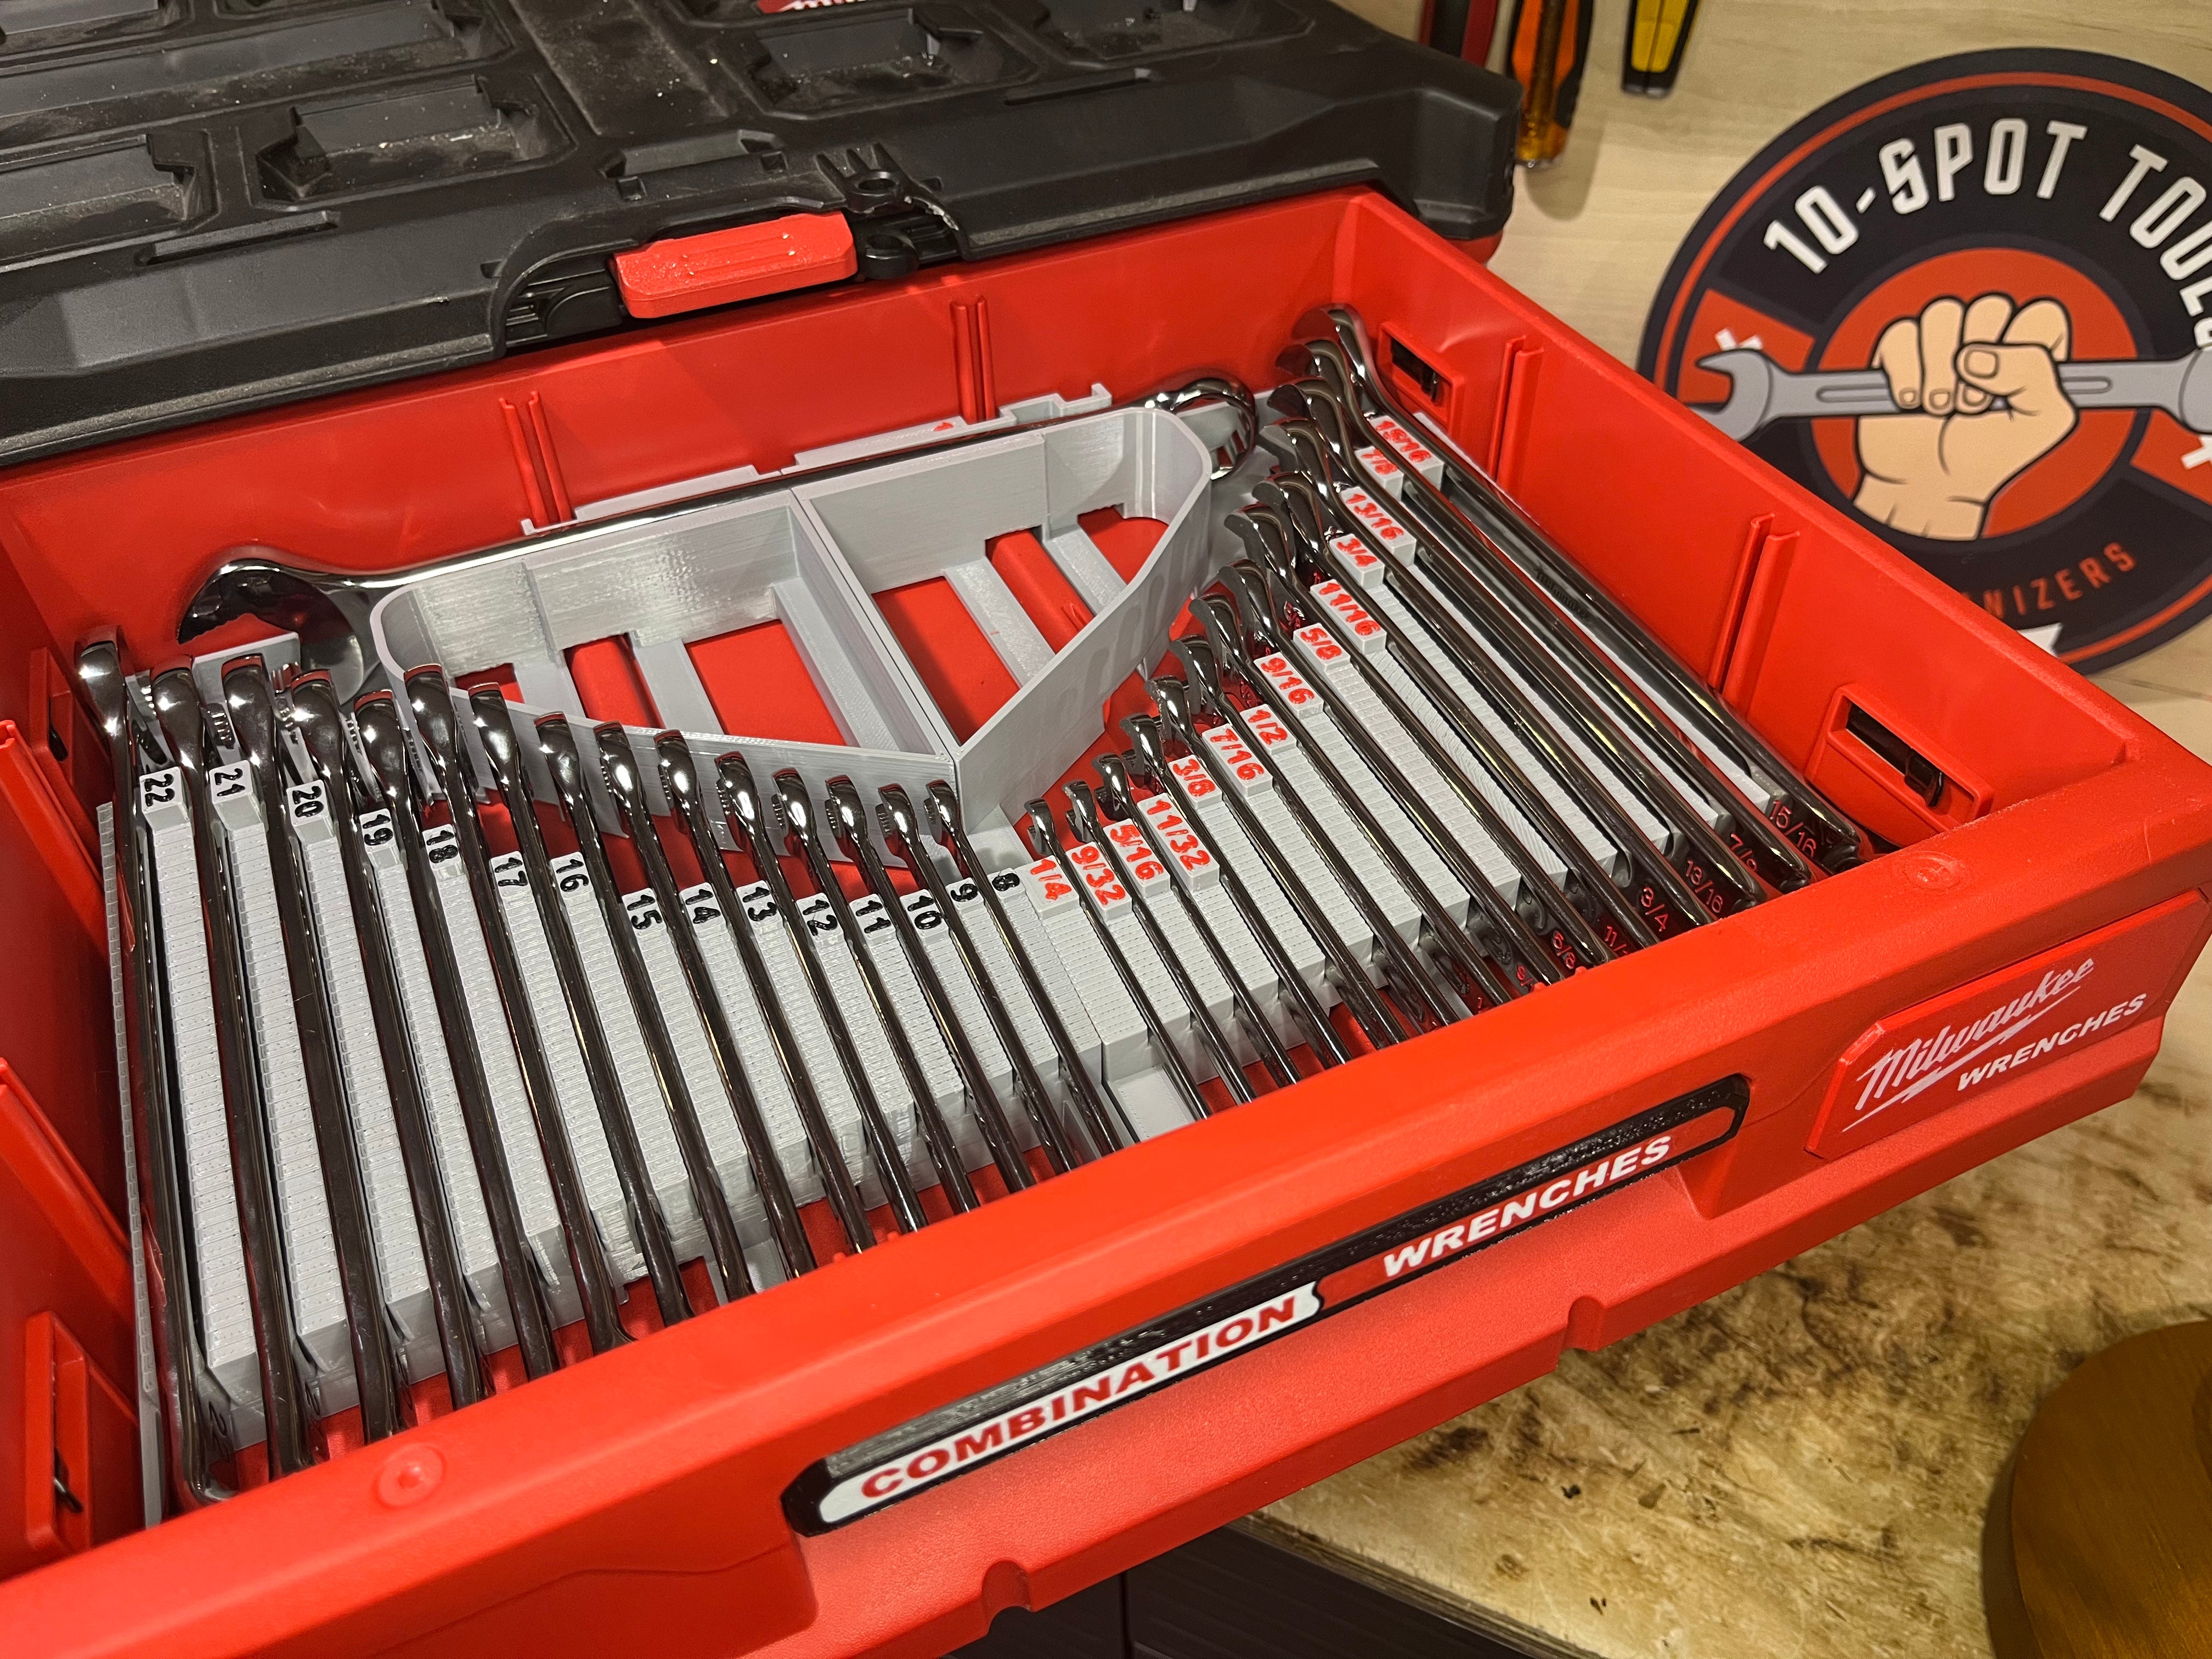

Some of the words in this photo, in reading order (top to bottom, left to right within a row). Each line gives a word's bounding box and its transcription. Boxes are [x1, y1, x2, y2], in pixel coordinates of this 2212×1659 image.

[1764, 119, 2087, 273] 10-SPOT
[2099, 145, 2212, 345] TOOL
[1347, 493, 1404, 540] 13/16
[1337, 538, 1378, 567] 3/4
[1960, 542, 2136, 619] NIZERS
[1319, 583, 1380, 636] 11/16
[1300, 628, 1342, 660] 5/8
[1261, 657, 1314, 704] 9/16
[1248, 709, 1288, 746] 1/2
[1210, 728, 1264, 780] 7/16
[144, 774, 175, 807] 22
[214, 768, 245, 797] 21
[1172, 759, 1216, 797] 3/8
[292, 786, 324, 818] 20
[363, 814, 393, 846] 19
[426, 830, 459, 864] 18
[1147, 799, 1210, 871] 11/32
[1769, 800, 1817, 857] 15/16
[1110, 824, 1164, 880] 5/16
[494, 856, 531, 887] 17
[556, 859, 589, 892] 16
[991, 873, 1020, 892] 8
[1030, 859, 1072, 900] 1/4
[1071, 846, 1126, 906] 9/32
[1685, 859, 1724, 913] 13/16
[685, 889, 721, 924] 14
[742, 886, 777, 922] 13
[950, 883, 978, 902] 9
[1640, 885, 1668, 932] 3/4
[627, 894, 663, 930] 15
[802, 899, 838, 936] 12
[855, 900, 891, 934] 11
[907, 895, 943, 930] 10
[1855, 958, 2094, 1111] Milwaukee
[1956, 993, 2147, 1091] WRENCHES
[861, 1296, 1296, 1498] COMBINATION
[1384, 1136, 1672, 1277] WRENCHES
